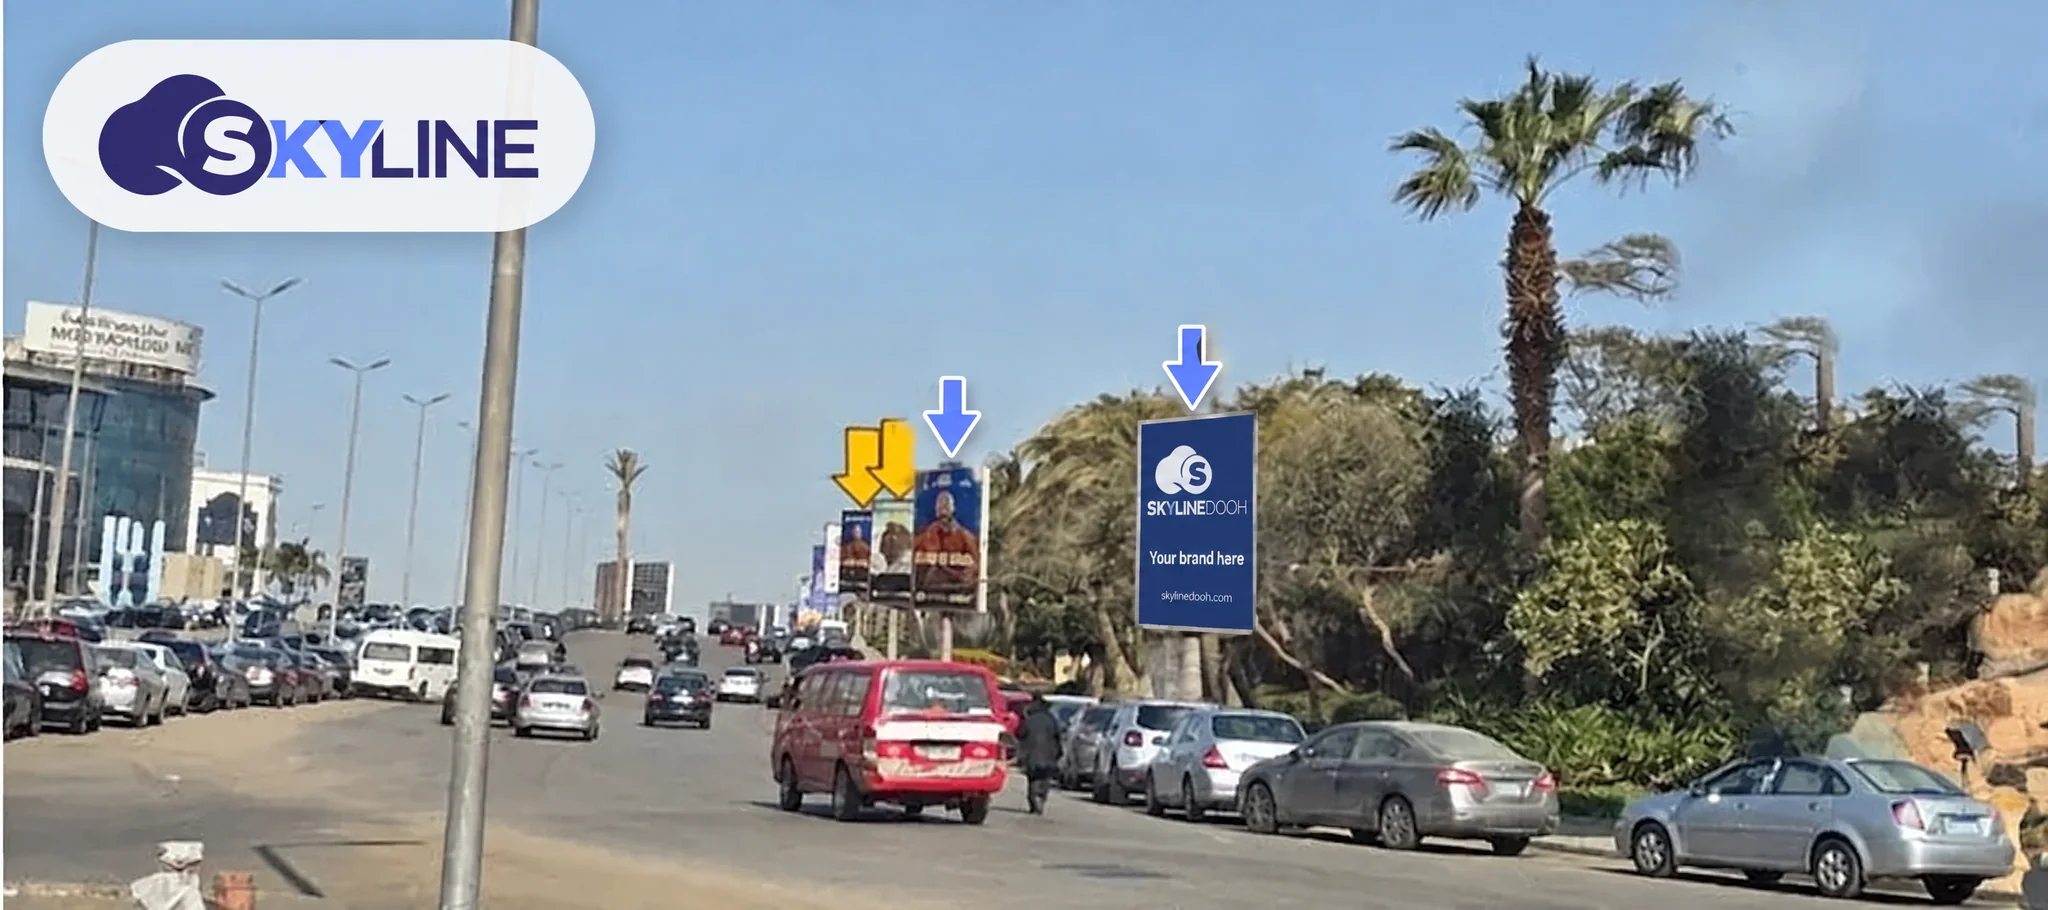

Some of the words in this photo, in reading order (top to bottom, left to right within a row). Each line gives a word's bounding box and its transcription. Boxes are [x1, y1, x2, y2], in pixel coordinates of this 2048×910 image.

[1189, 461, 1206, 486] S
[1147, 500, 1247, 515] SKYLINEDOOH
[1150, 551, 1176, 565] Your
[1179, 551, 1214, 565] brand
[1217, 551, 1244, 565] here
[1161, 591, 1232, 602] skylinedooh.com
